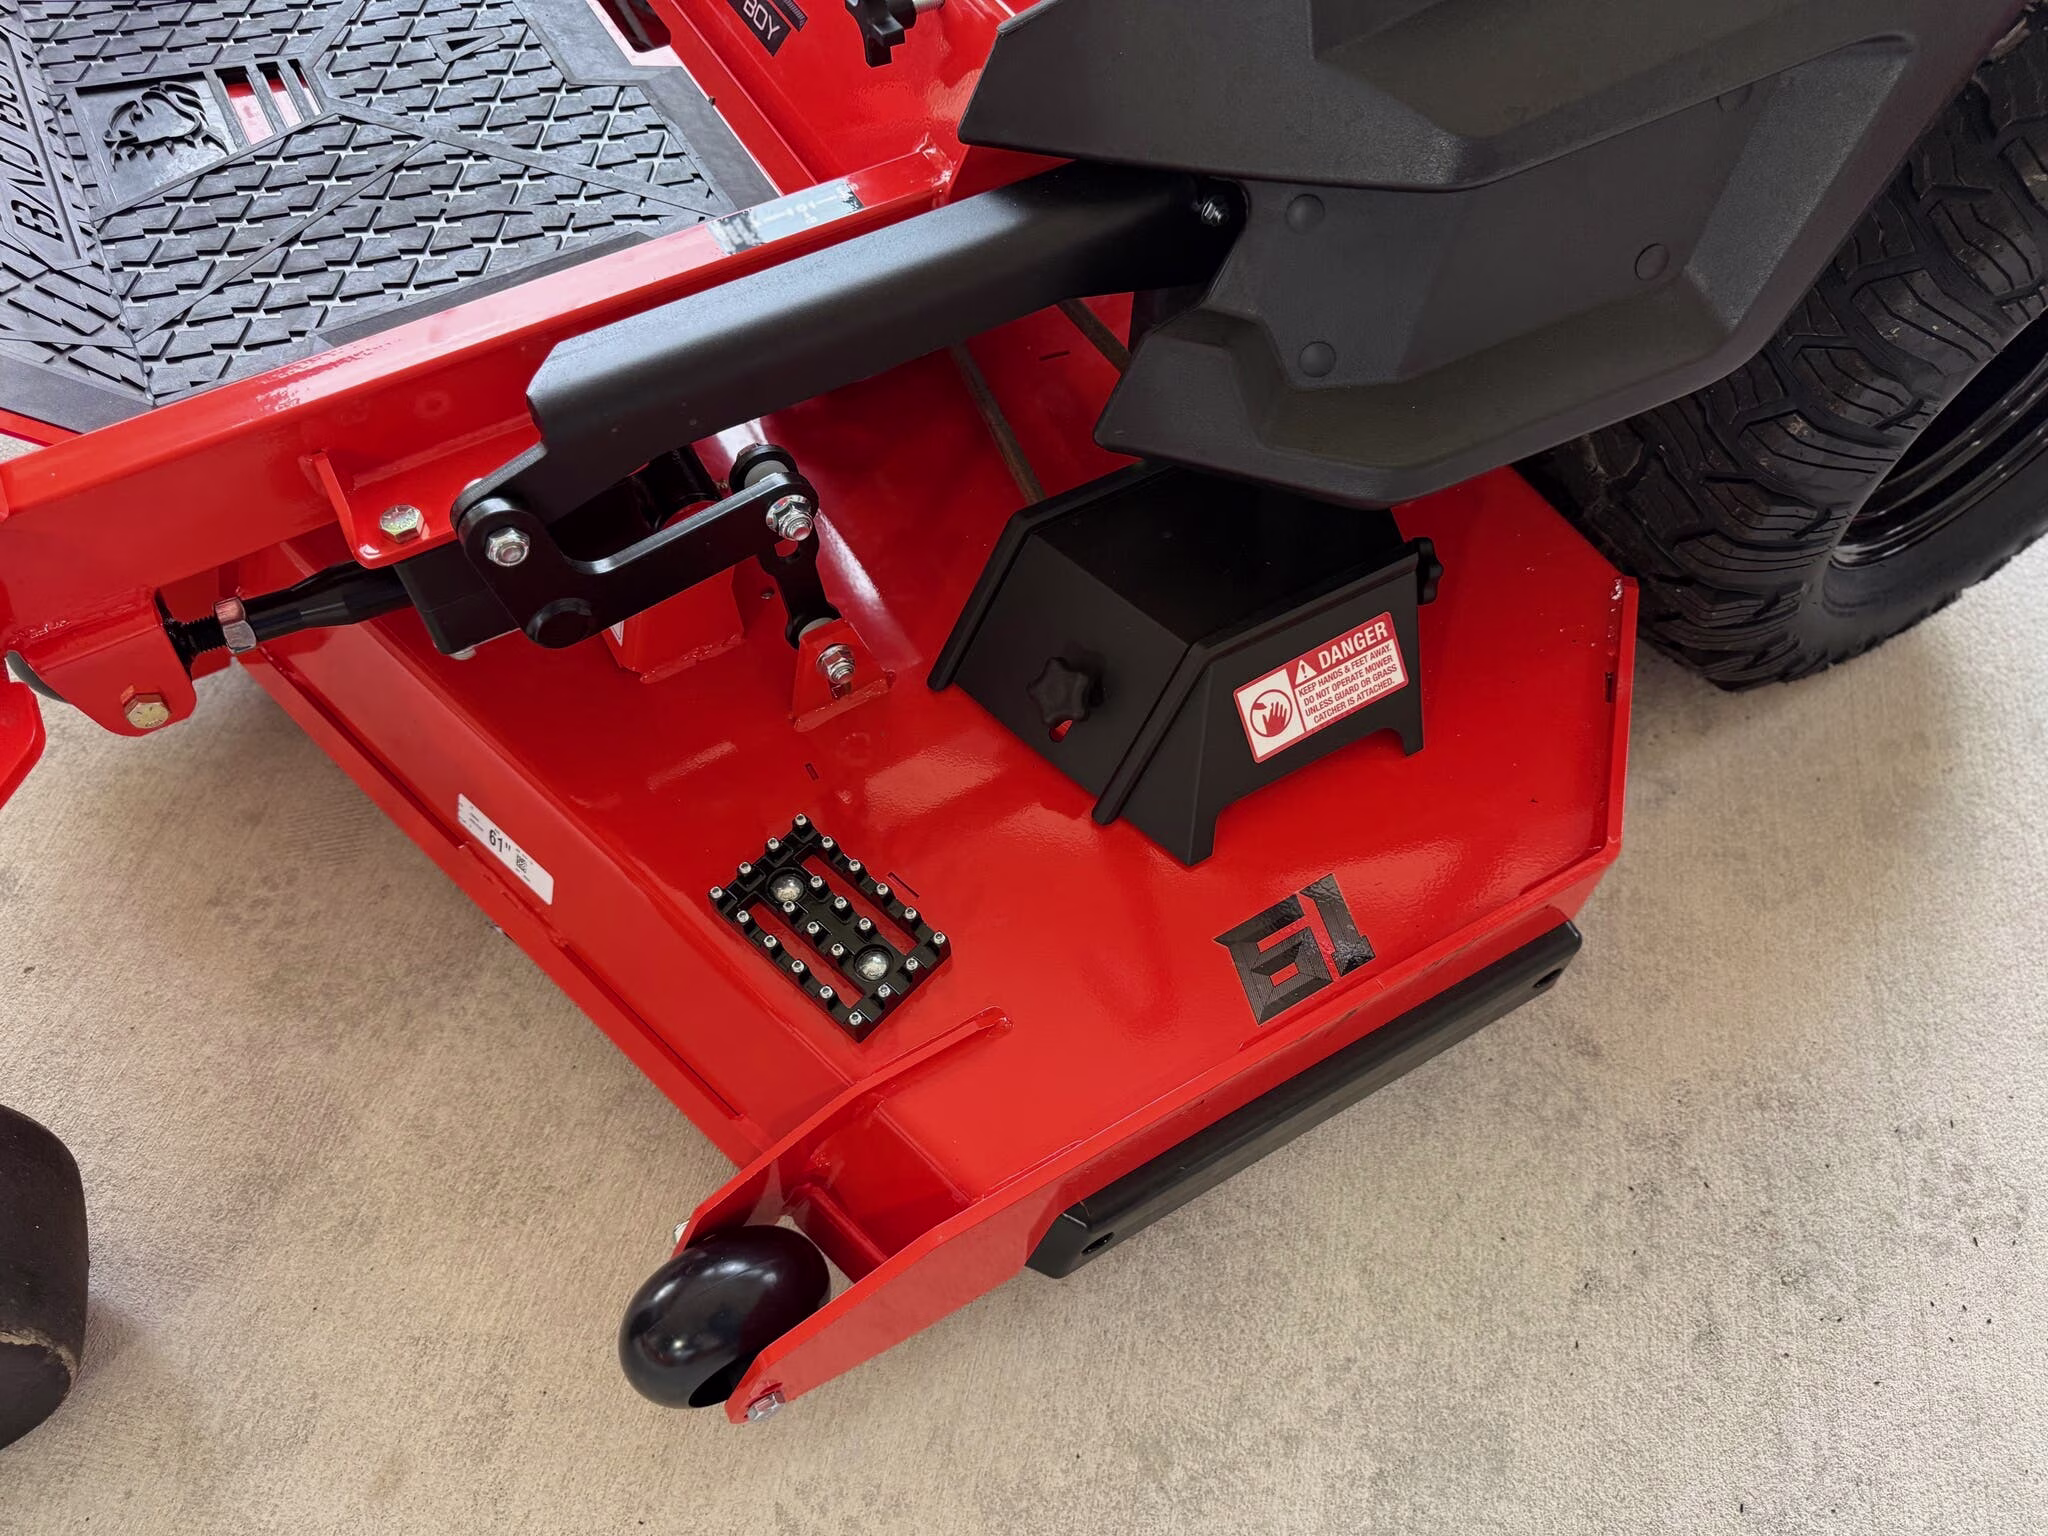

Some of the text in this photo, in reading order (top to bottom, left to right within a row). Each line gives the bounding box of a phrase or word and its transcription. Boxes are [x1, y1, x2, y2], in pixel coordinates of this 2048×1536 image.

[743, 0, 780, 40] BOY
[1318, 621, 1389, 669] DANGER
[1298, 643, 1392, 697] KEEP HANDS & FEET AWAY.
[1304, 655, 1393, 706] DO NOT OPERATE MOWER
[1305, 664, 1397, 717] UNLESS GUARD OR GRASS
[1313, 677, 1395, 723] CATCHER IS ATTACHED.
[489, 829, 511, 852] 61"
[1213, 873, 1376, 1025] 61
